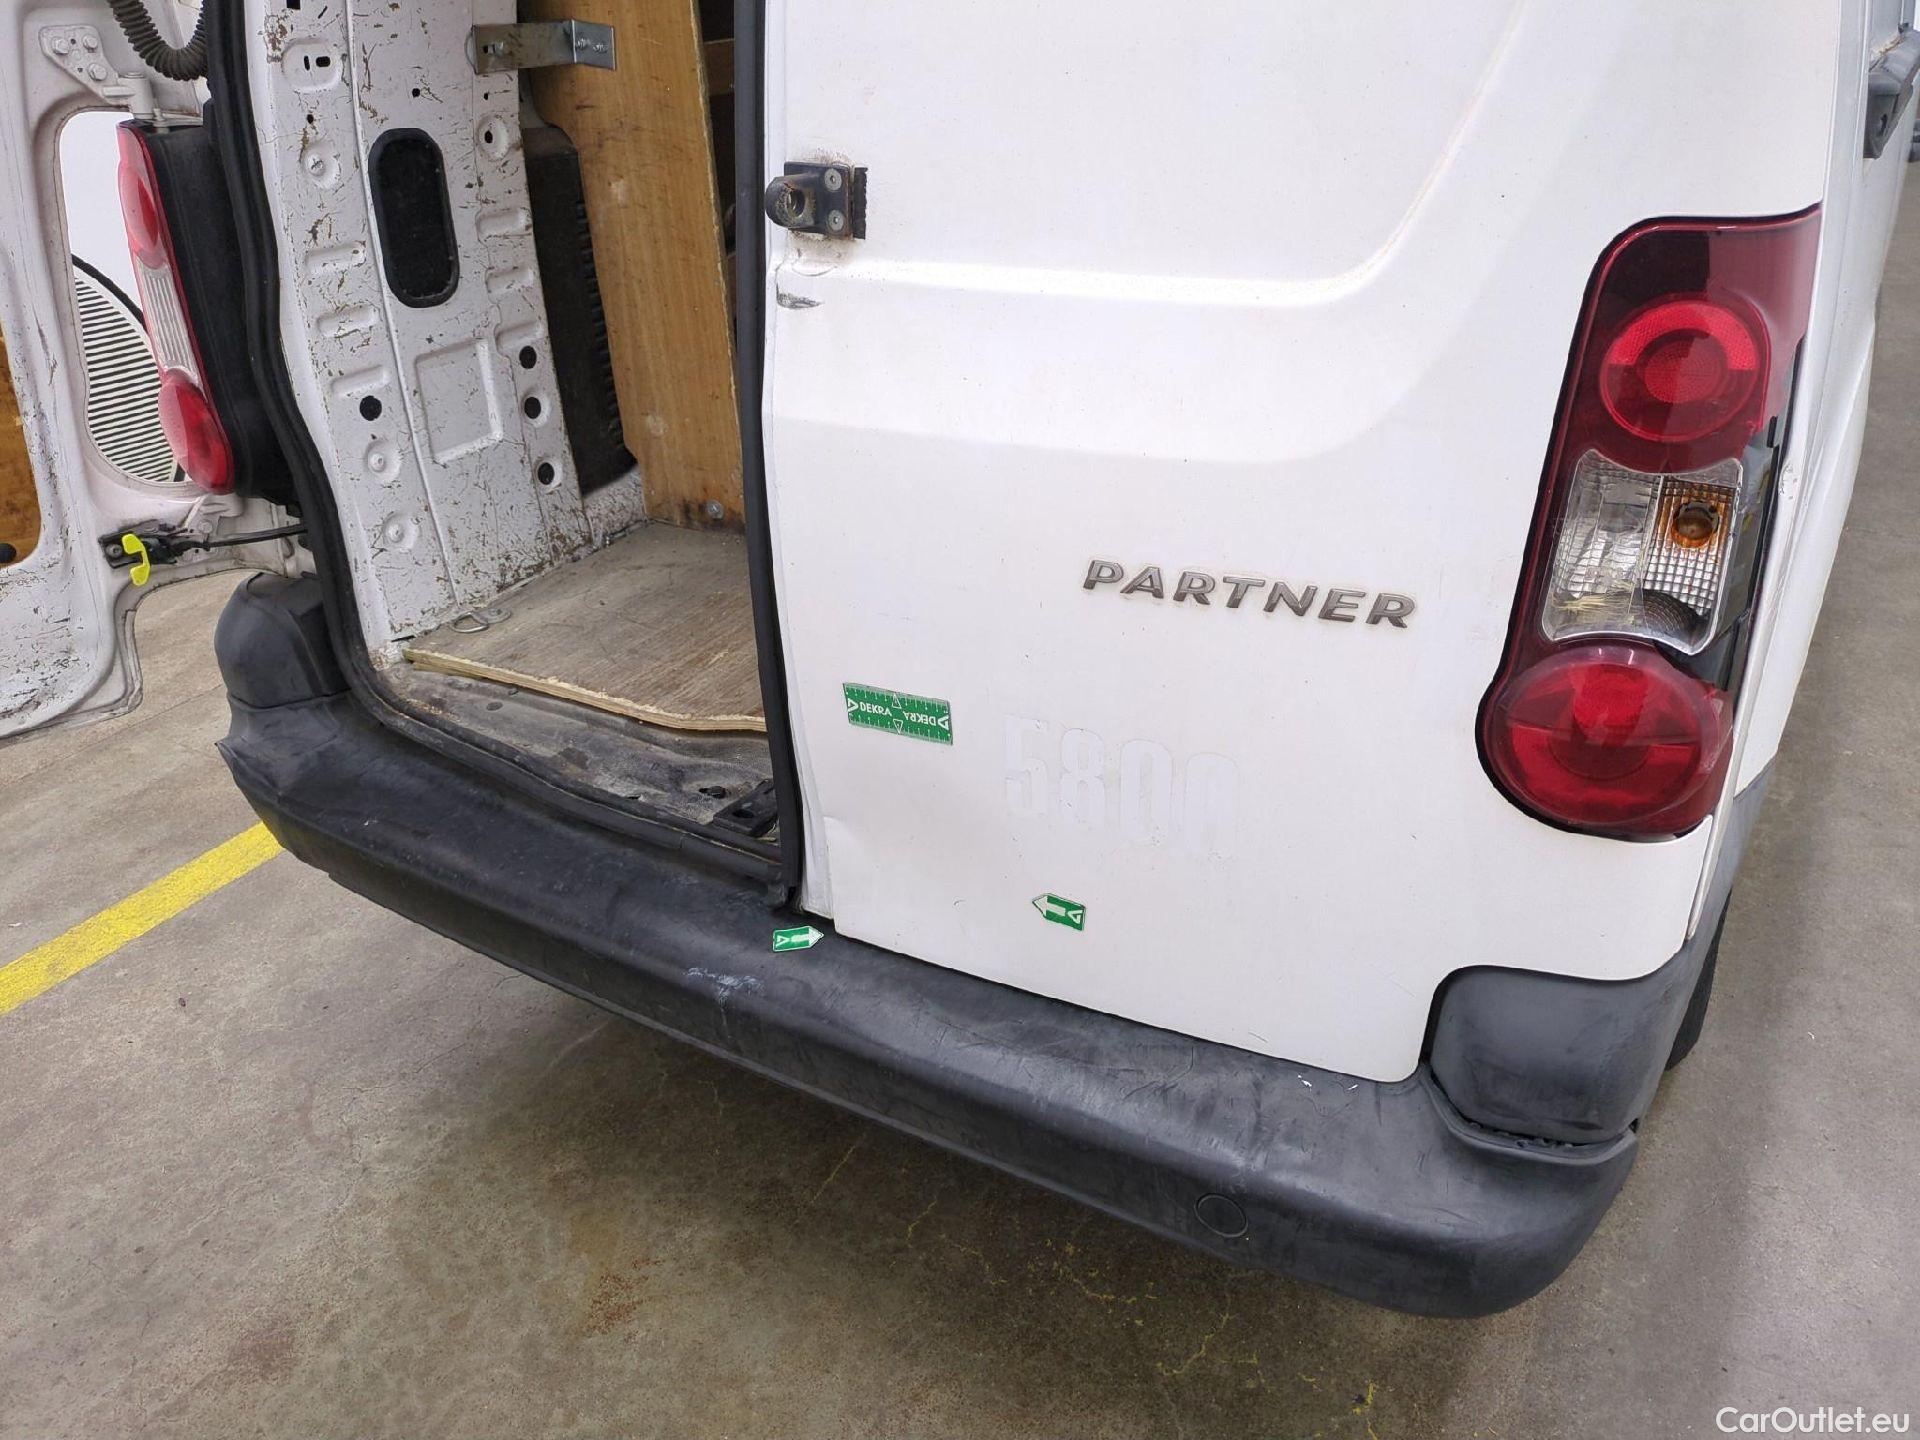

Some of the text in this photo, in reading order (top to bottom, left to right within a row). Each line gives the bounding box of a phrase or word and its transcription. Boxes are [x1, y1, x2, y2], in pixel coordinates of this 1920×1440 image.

[1083, 559, 1417, 628] PARTNER
[860, 701, 893, 717] DEKRA
[902, 710, 936, 727] DEKRA
